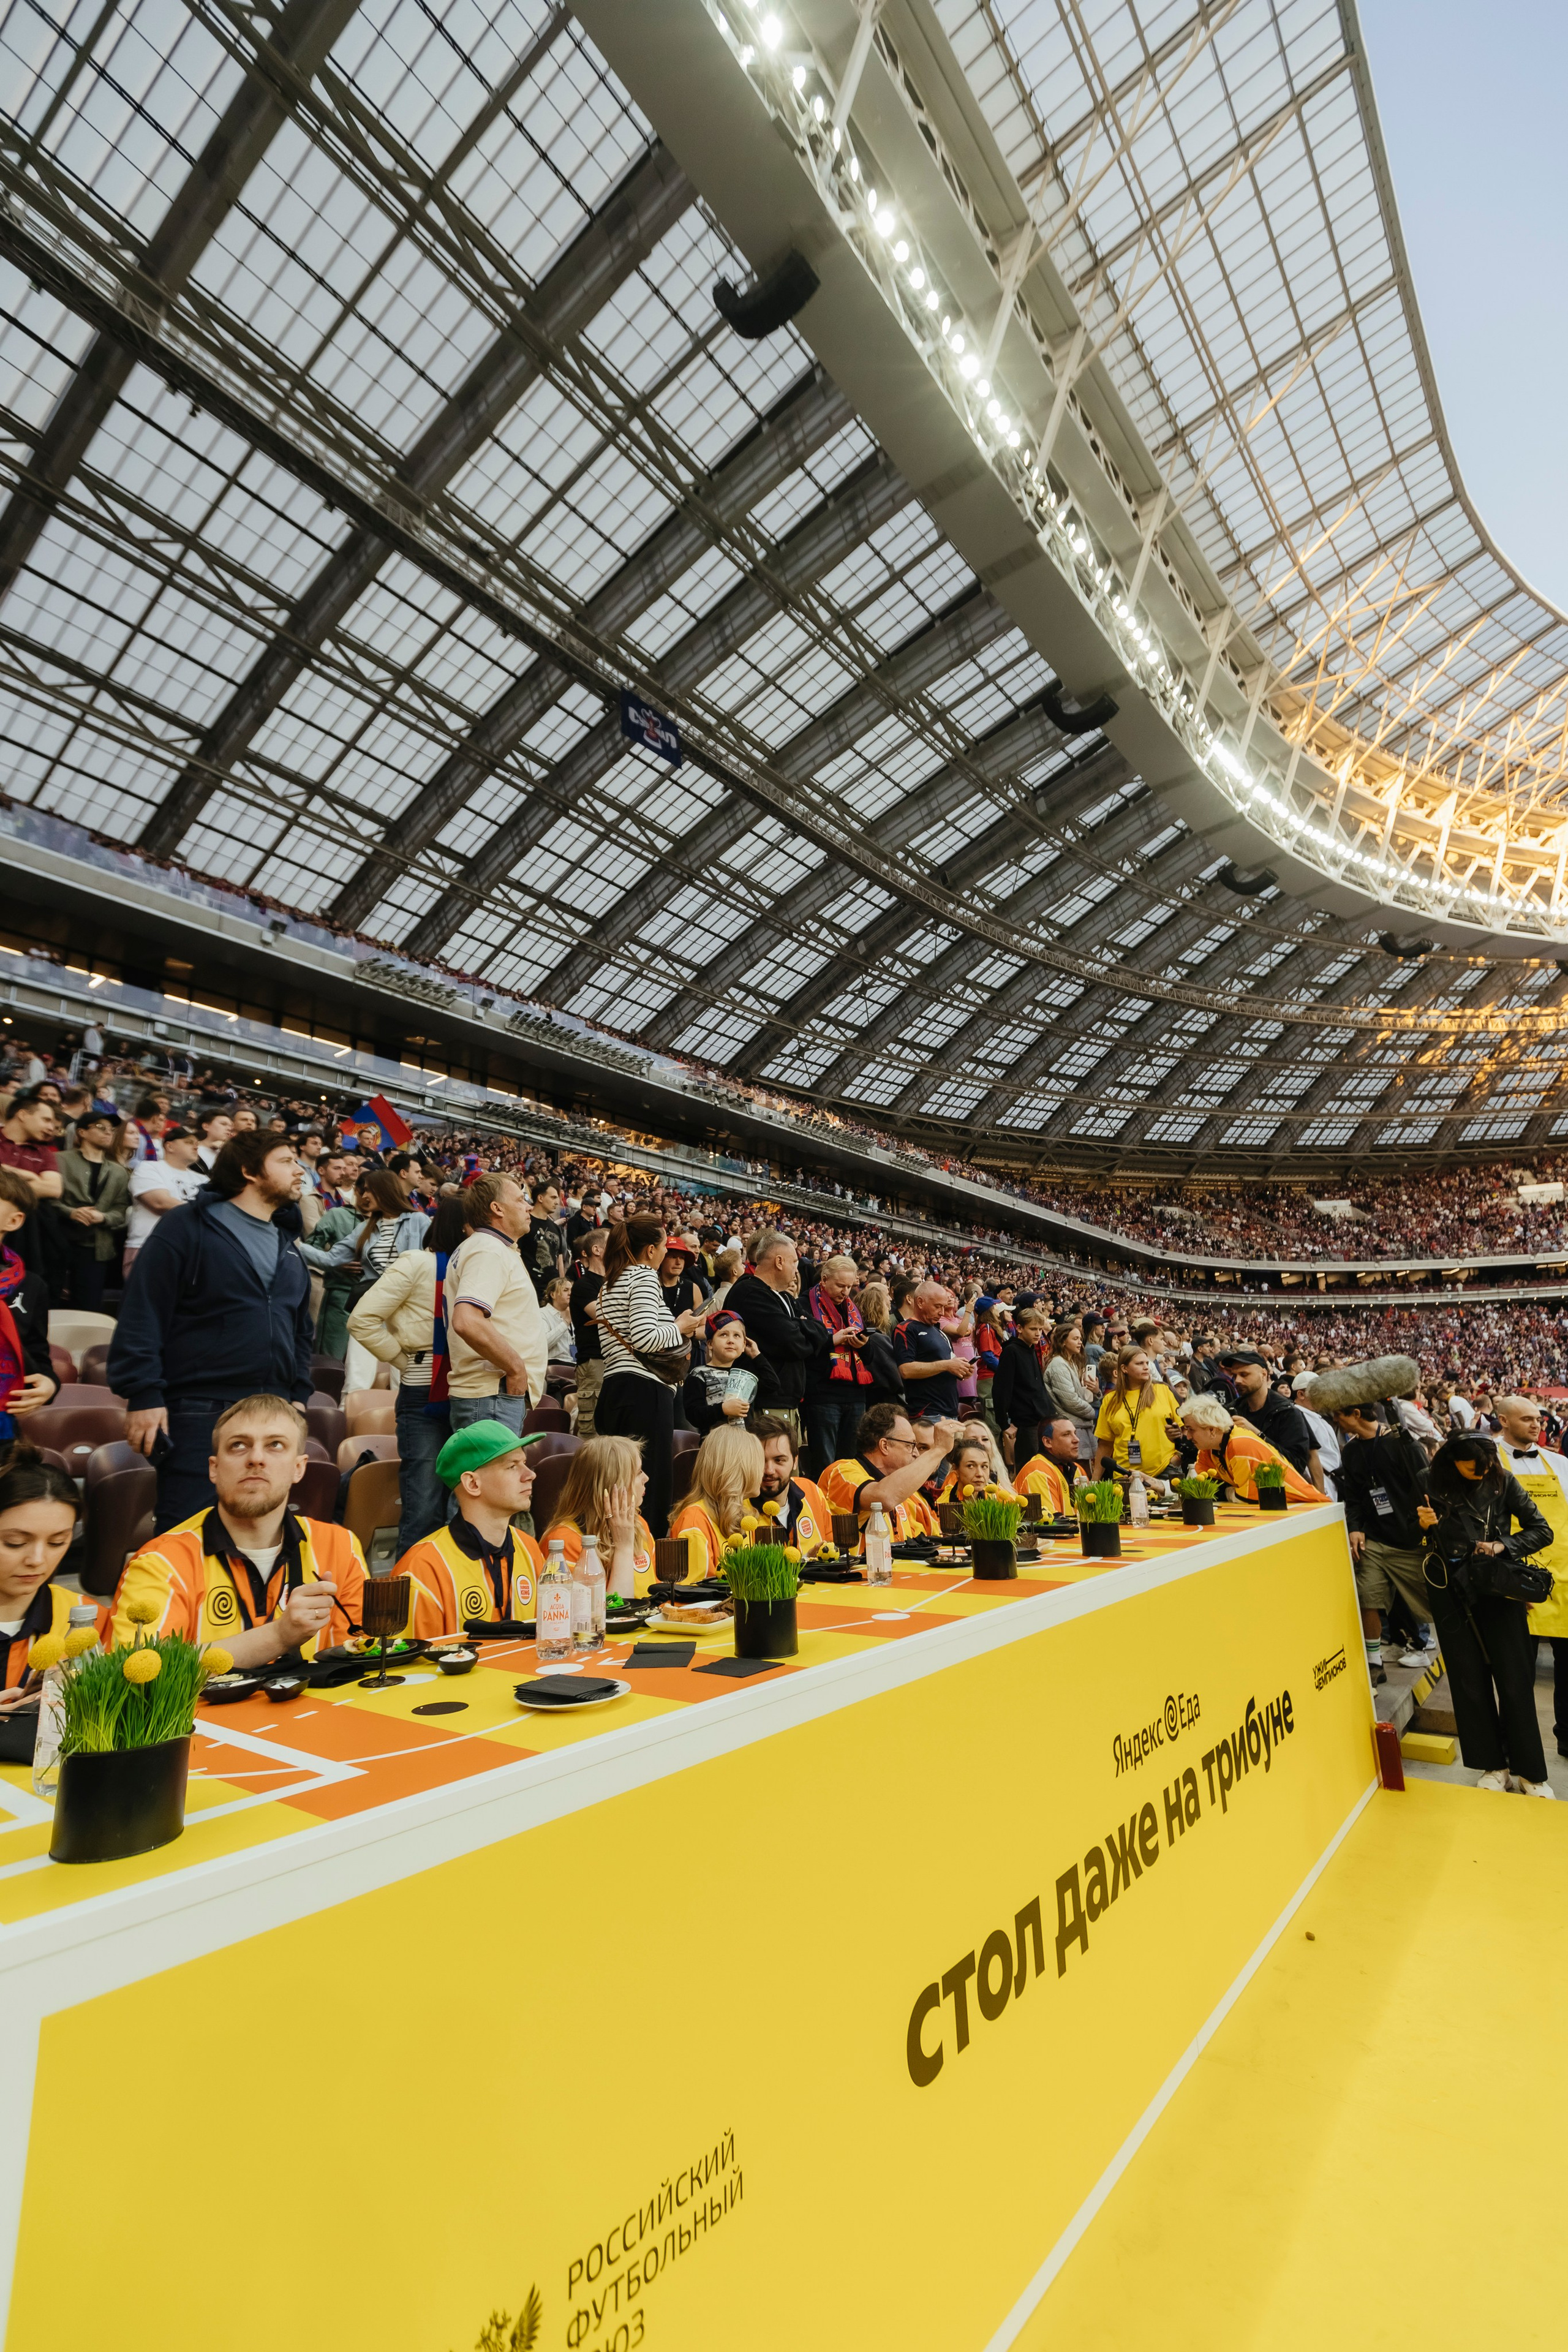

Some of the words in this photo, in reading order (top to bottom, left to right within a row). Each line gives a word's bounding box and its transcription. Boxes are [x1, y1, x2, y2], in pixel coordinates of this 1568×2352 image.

[543, 1610, 569, 1621] PANNA
[1313, 1644, 1345, 1679] УЖИН
[1314, 1657, 1347, 1692] ЧЕМПИОНОВ
[1113, 1717, 1164, 1778] Яндекс
[1178, 1692, 1201, 1730] Еда
[907, 1895, 1045, 2087] стол
[1055, 1802, 1159, 1978] даже
[1163, 1767, 1201, 1847] на
[1201, 1690, 1294, 1814] трибуне
[567, 2127, 736, 2301] РОССИЙСКИЙ
[566, 2165, 744, 2350] ФУТБОЛЬНЫЙ
[592, 2308, 645, 2352] ЮЗ
